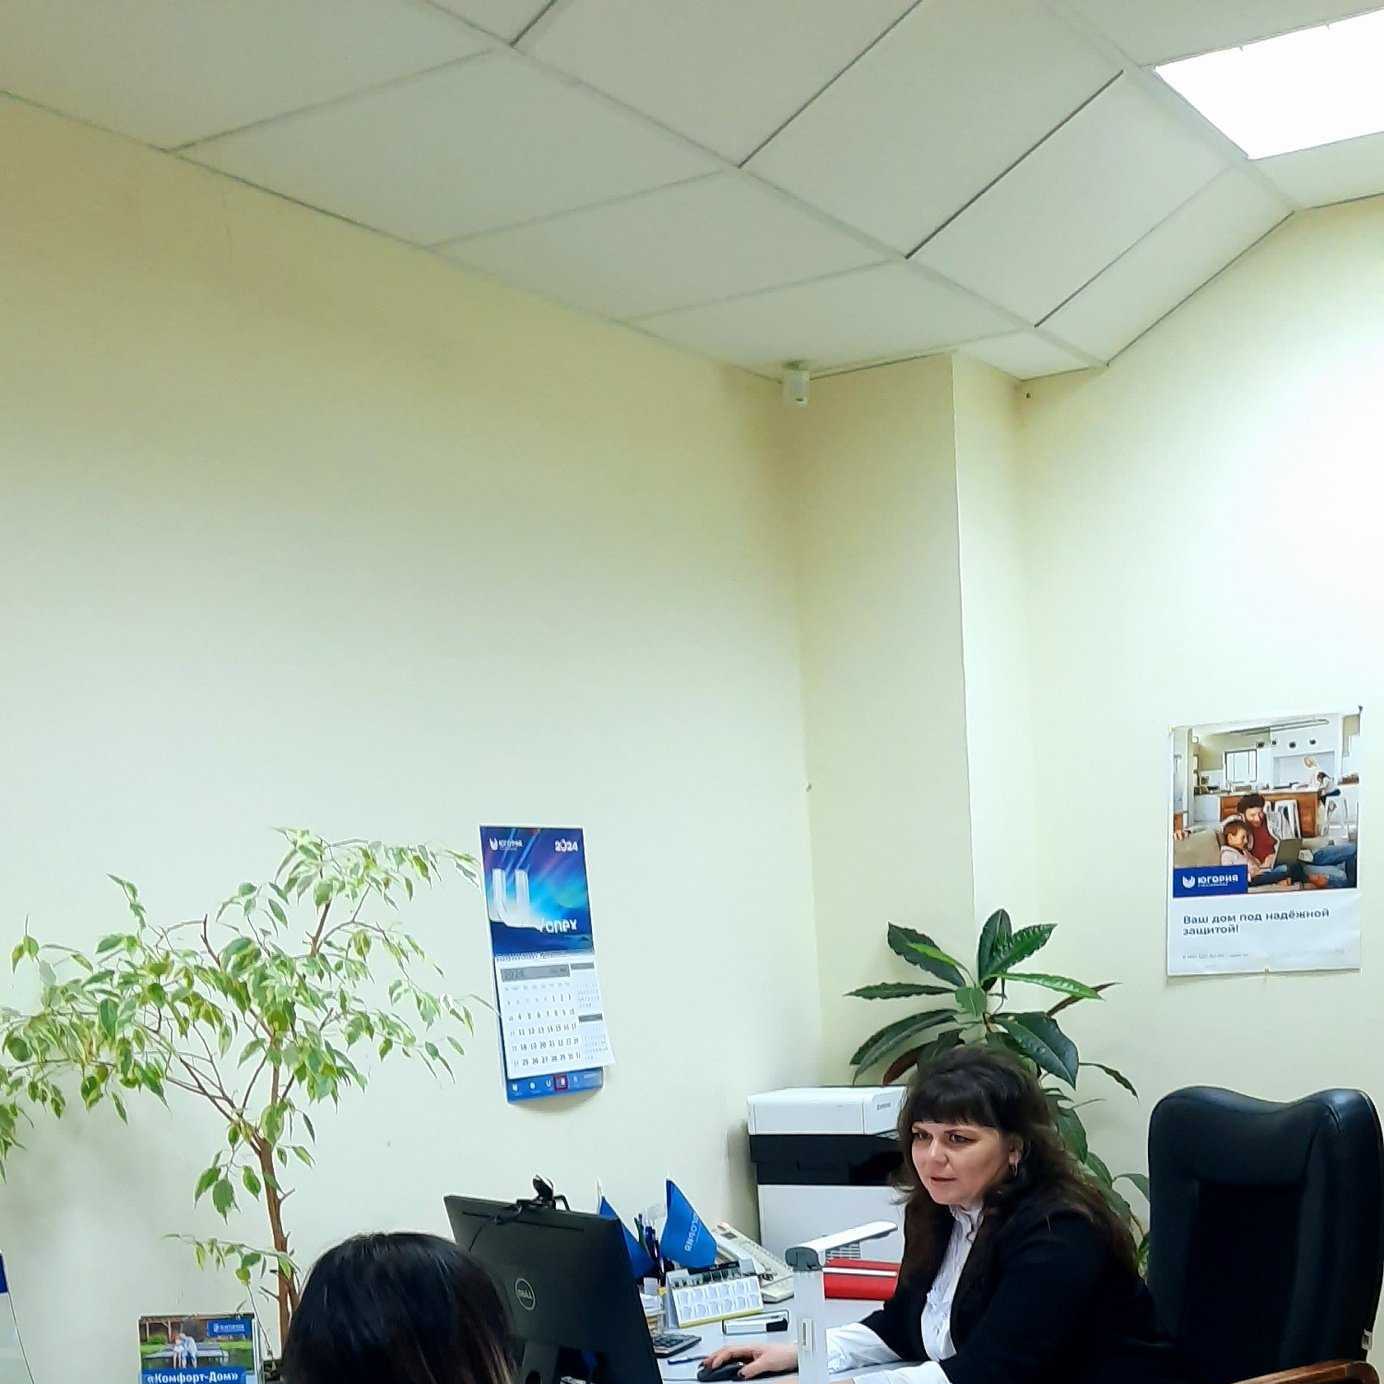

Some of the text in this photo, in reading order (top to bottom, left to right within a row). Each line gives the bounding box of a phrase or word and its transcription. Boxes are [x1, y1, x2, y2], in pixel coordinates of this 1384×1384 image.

[555, 838, 578, 852] 2024
[1198, 874, 1238, 884] ЮГОРИЯ
[1183, 908, 1330, 925] Ваш дом под надёжной
[1183, 924, 1239, 936] защитой!
[147, 1371, 238, 1384] «Комфорт-Дом»
